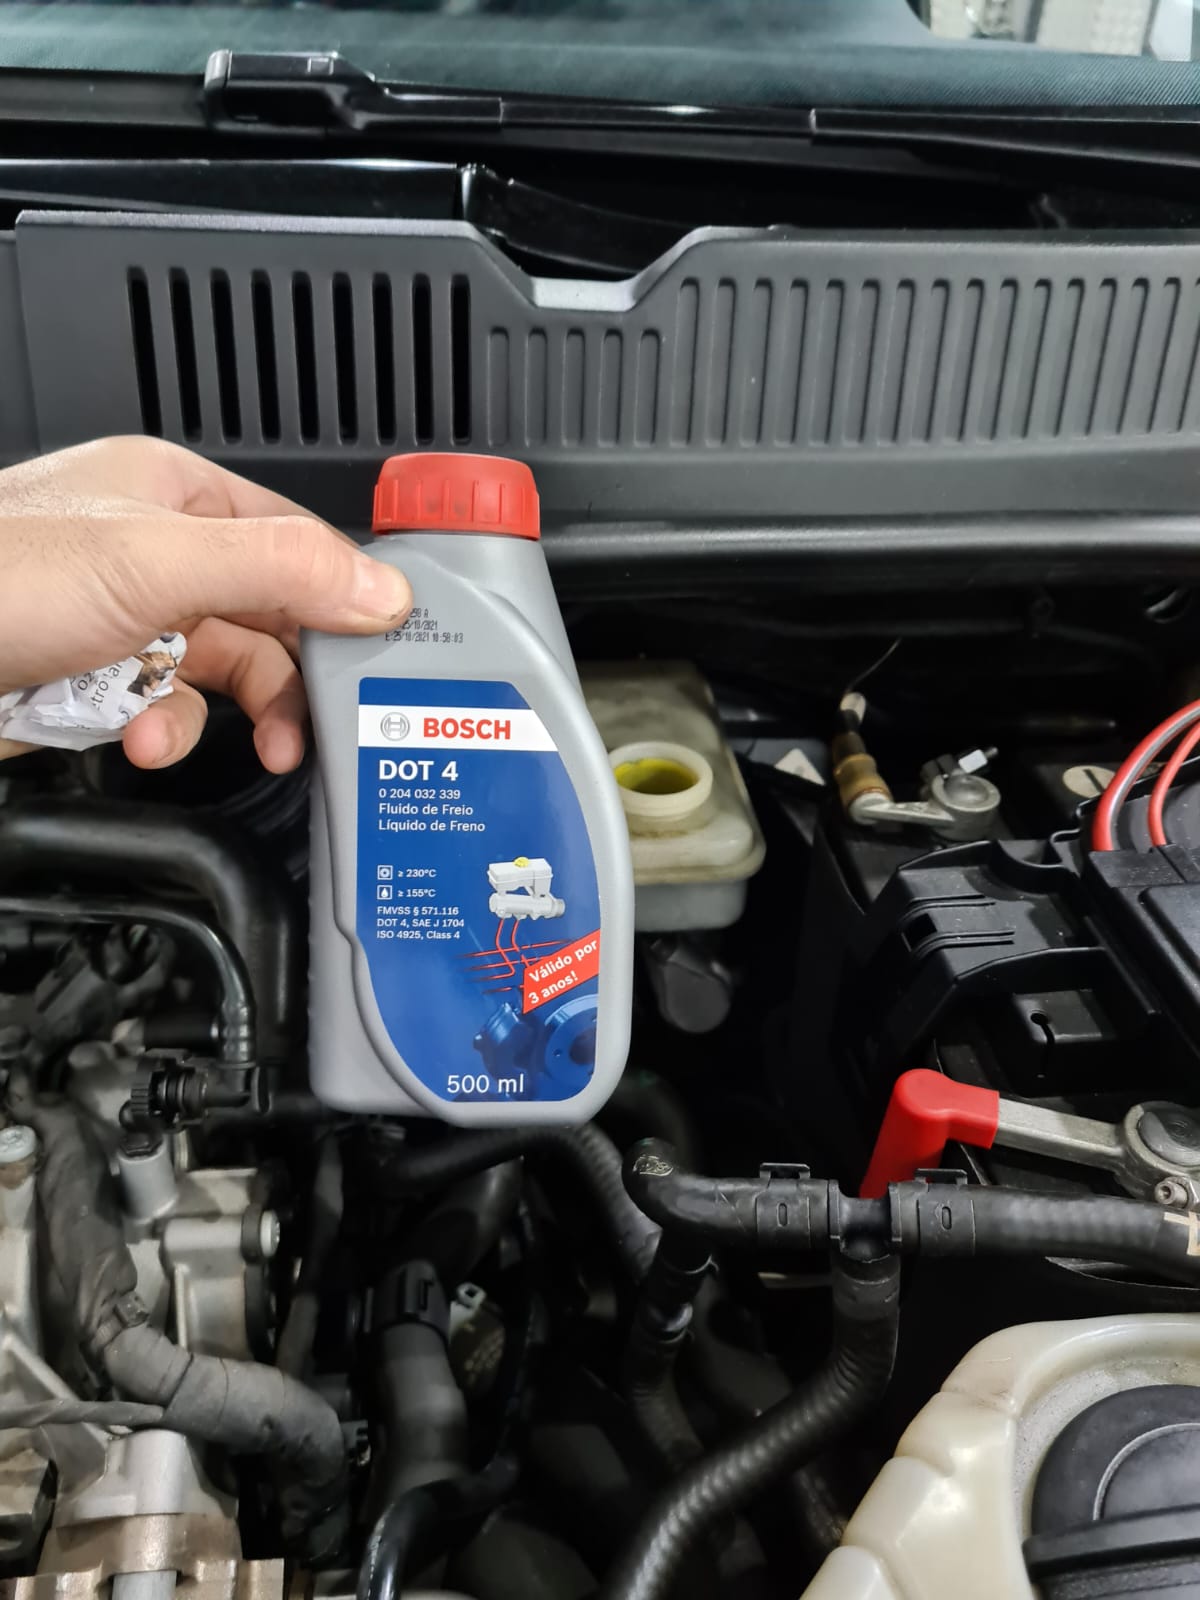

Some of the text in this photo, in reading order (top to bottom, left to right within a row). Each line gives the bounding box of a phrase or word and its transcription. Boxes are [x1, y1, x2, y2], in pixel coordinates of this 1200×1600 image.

[423, 608, 429, 618] A
[423, 717, 511, 740] BOSCH
[379, 759, 459, 781] DOT 4
[378, 788, 461, 800] 0 204 032 339
[379, 802, 474, 816] Fluido de Freio
[379, 819, 486, 832] Líquido de Freno
[377, 906, 411, 915] FMVSS
[421, 906, 459, 916] 571.116
[377, 918, 465, 929] DOT 4, SAE J 1704
[377, 930, 460, 940] ISO 4925, Class 4
[528, 940, 597, 982] Válido por
[528, 970, 578, 1004] 3 anos!
[447, 1073, 524, 1094] 500 ml
